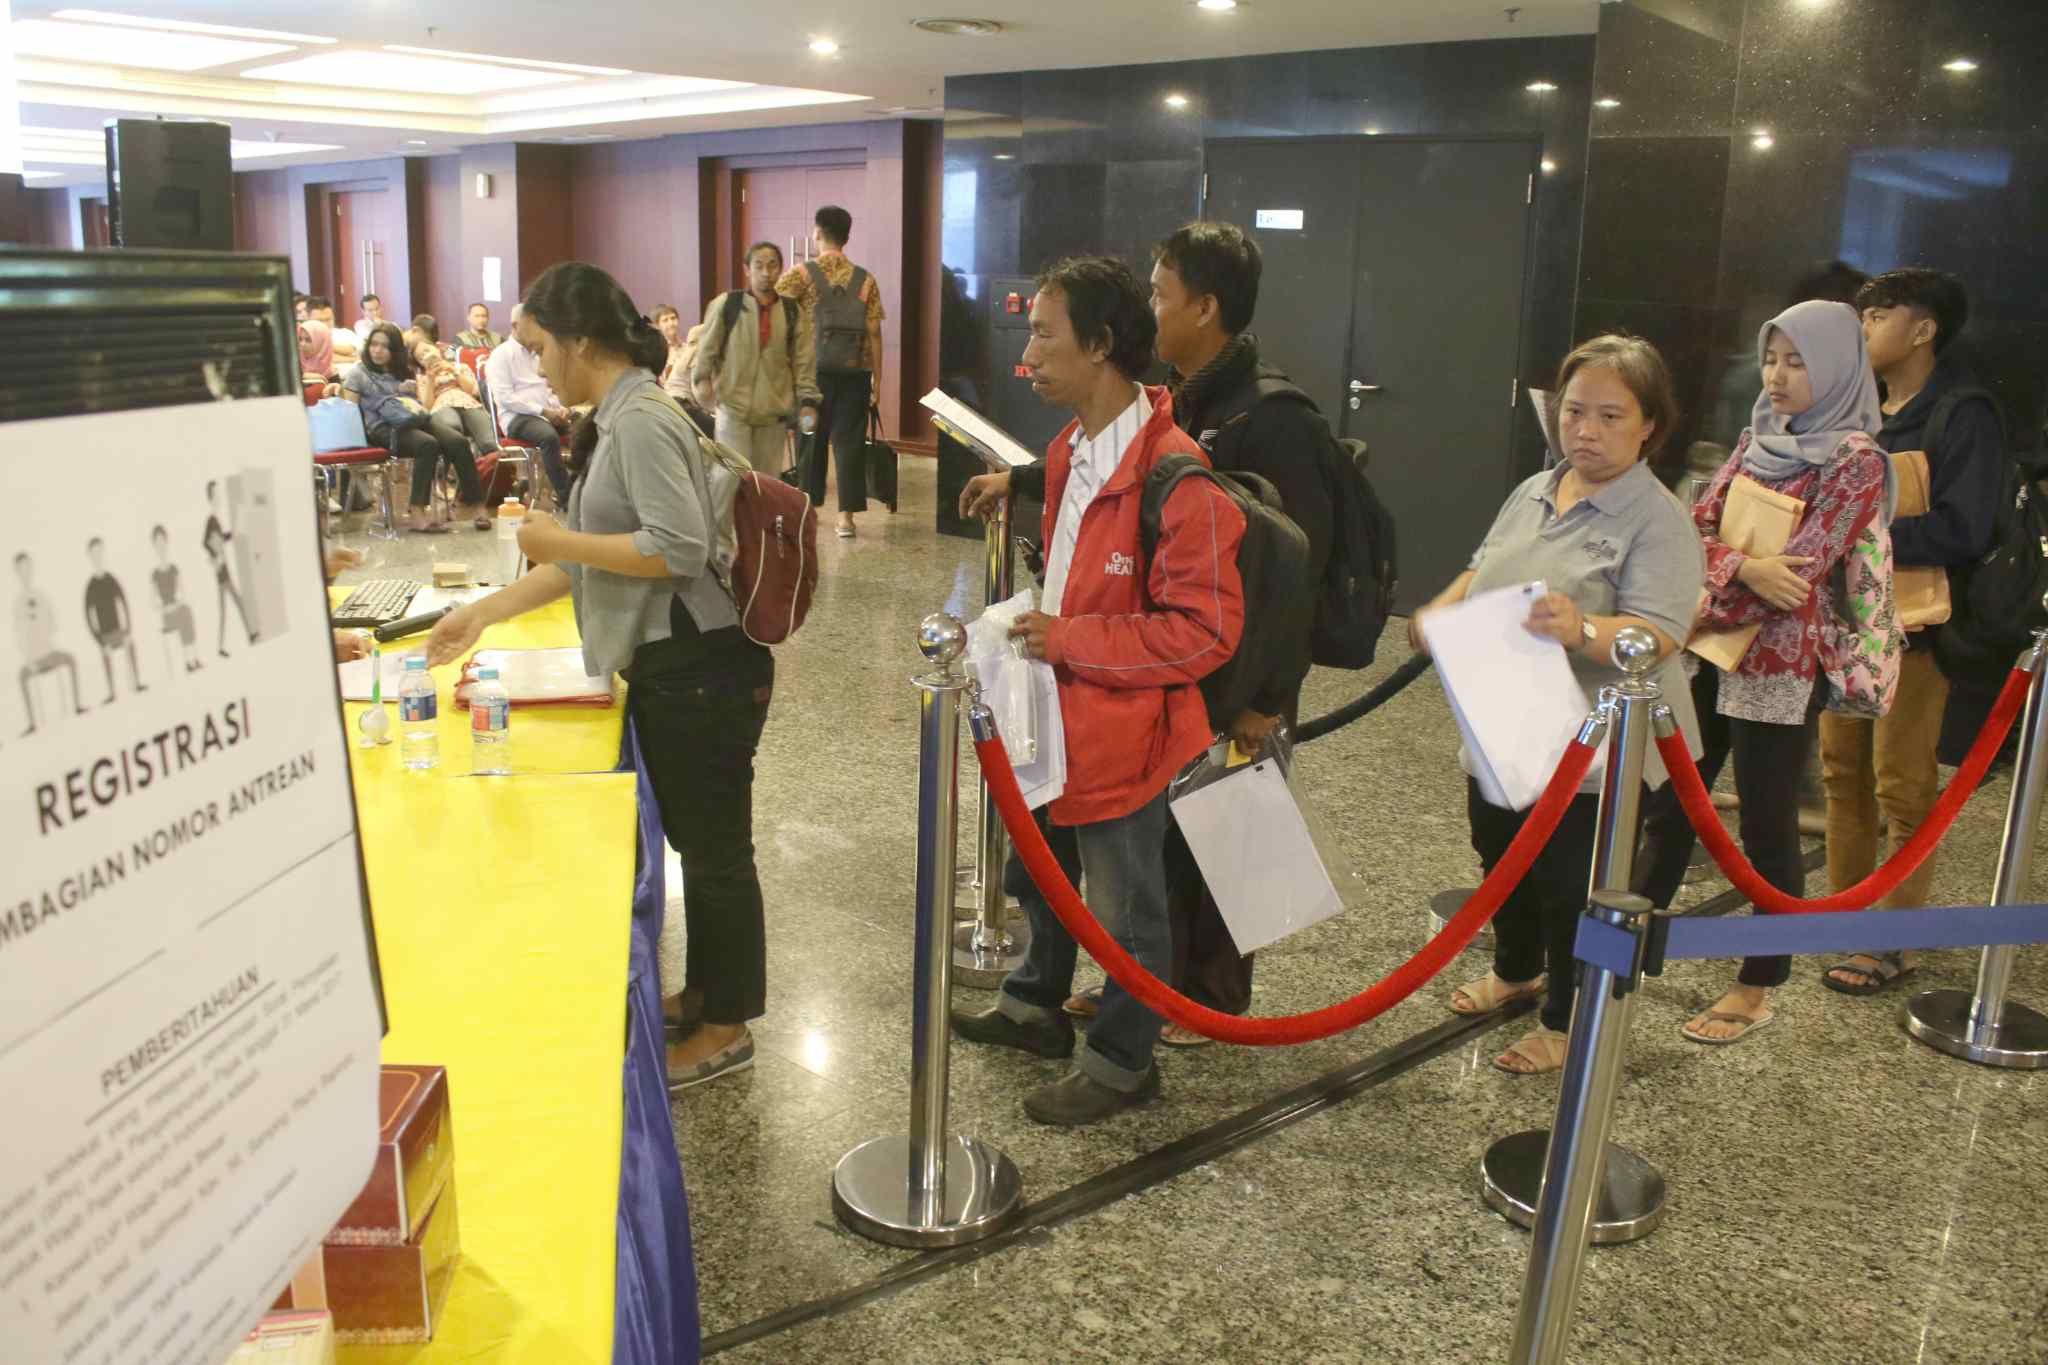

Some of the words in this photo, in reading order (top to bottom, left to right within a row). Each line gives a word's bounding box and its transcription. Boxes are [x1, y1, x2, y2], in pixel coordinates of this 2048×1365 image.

[35, 698, 251, 836] REGISTRASI
[132, 801, 220, 872] NOMOR
[227, 750, 317, 821] ANTREAN
[100, 964, 260, 1096] PEMBERITAHUAN
